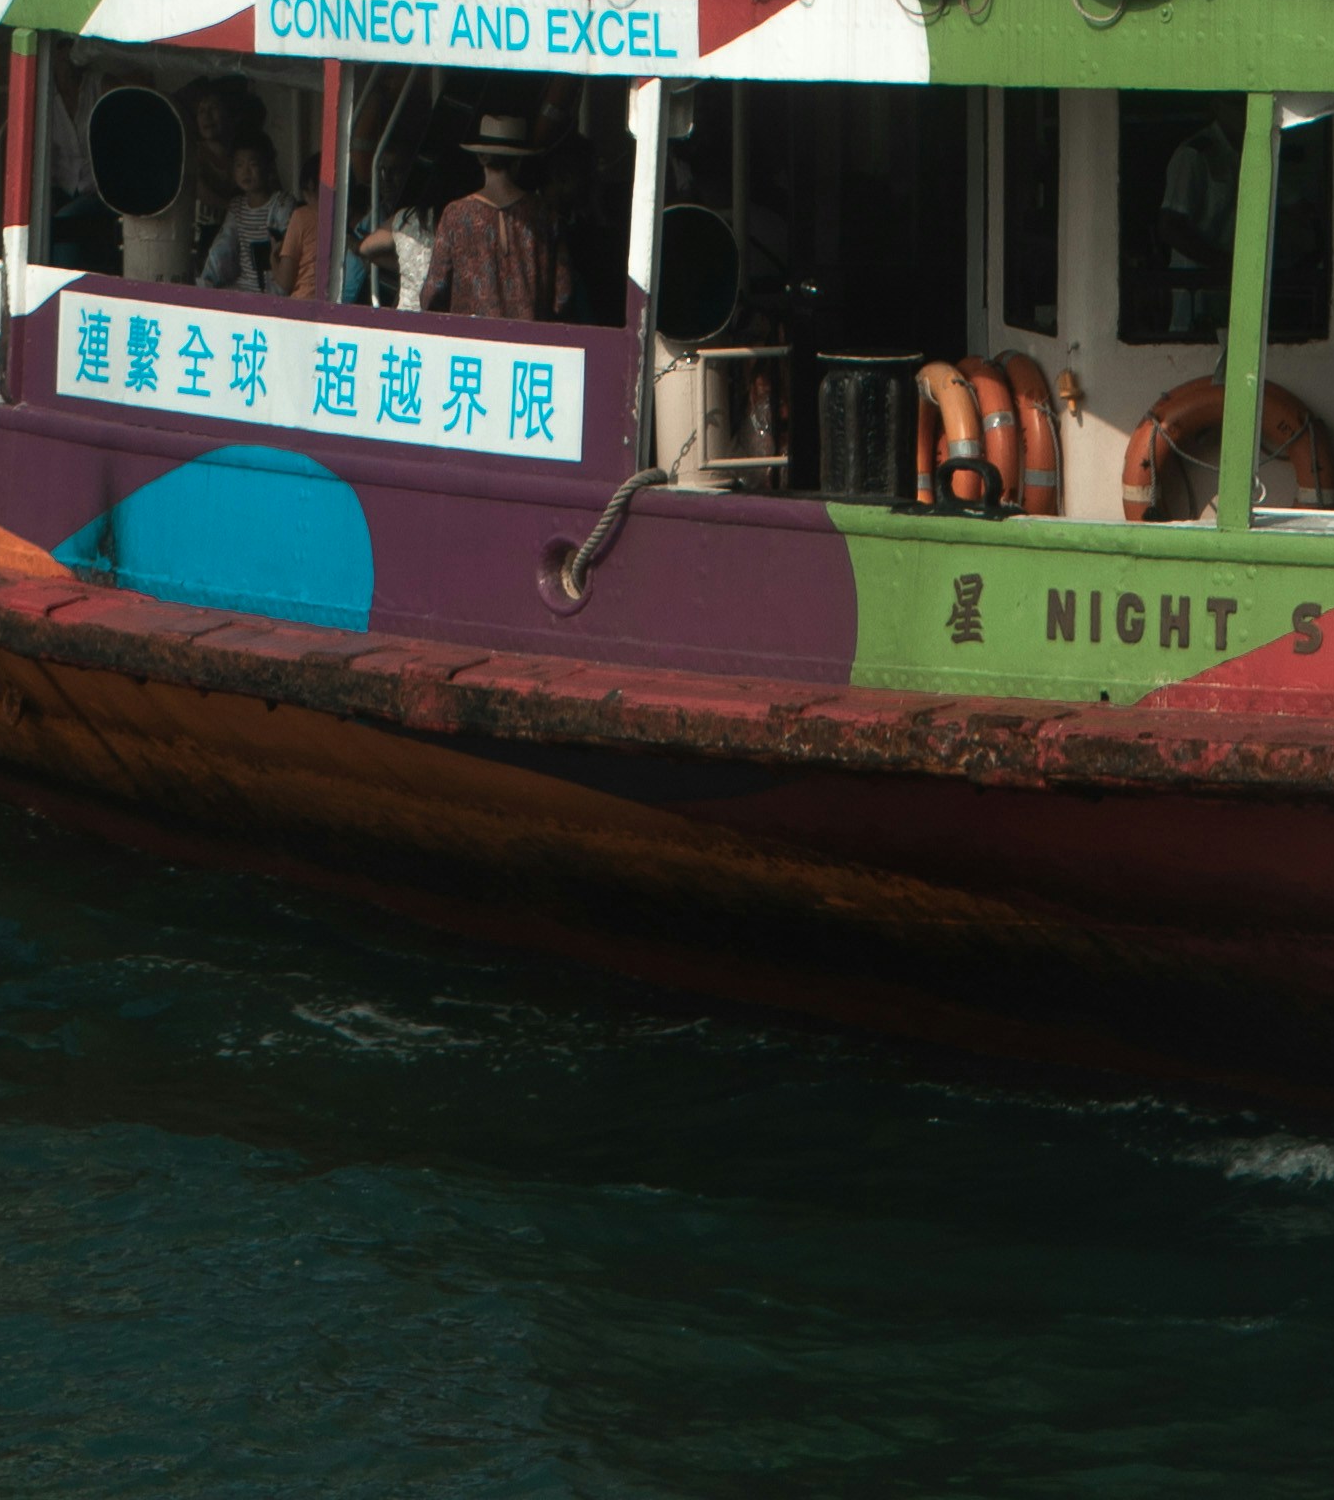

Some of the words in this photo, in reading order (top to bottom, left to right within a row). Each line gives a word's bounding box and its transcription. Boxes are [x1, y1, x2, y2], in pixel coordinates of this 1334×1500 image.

[449, 2, 531, 54] AND
[546, 6, 679, 61] EXCEL
[312, 337, 556, 444] 超越界限
[945, 572, 985, 645] 星
[1046, 588, 1238, 653] NIGHT
